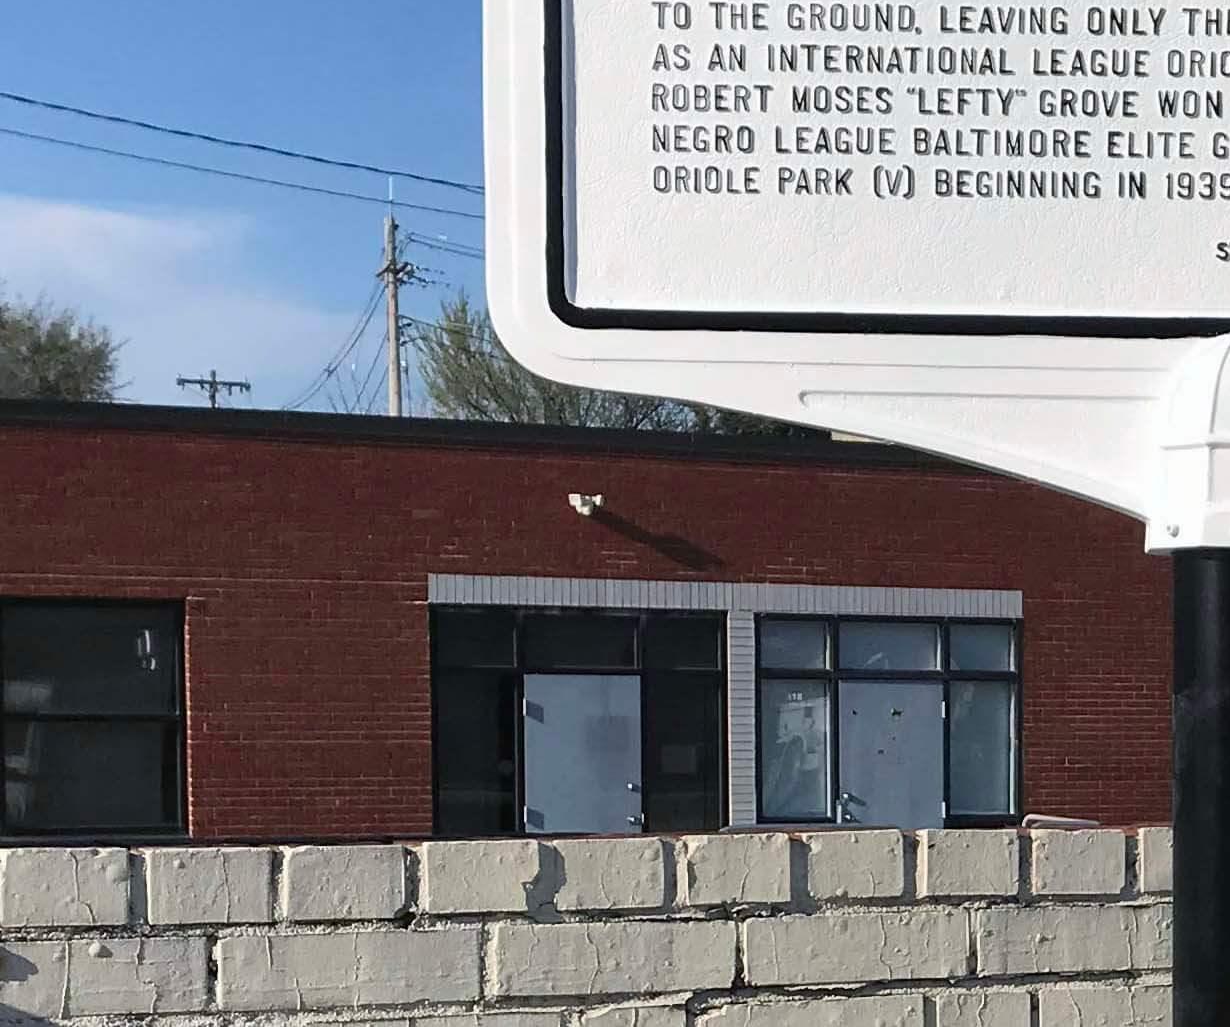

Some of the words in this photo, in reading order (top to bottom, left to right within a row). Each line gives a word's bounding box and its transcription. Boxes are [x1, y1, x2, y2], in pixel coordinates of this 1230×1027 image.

[651, 43, 691, 72] AS
[707, 43, 747, 72] AN
[767, 43, 1017, 76] INTERNATIONAL
[1032, 48, 1151, 78] LEAGUE
[652, 123, 755, 155] NEGRO
[775, 125, 897, 156] LEAGUE
[913, 127, 1092, 159] BALTIMORE
[1107, 130, 1196, 160] ELITE
[653, 165, 761, 195] ORIOLE
[778, 166, 854, 196] PARK
[873, 164, 916, 201] (V)
[934, 168, 1102, 199] BEGINNING
[1118, 171, 1147, 200] IN
